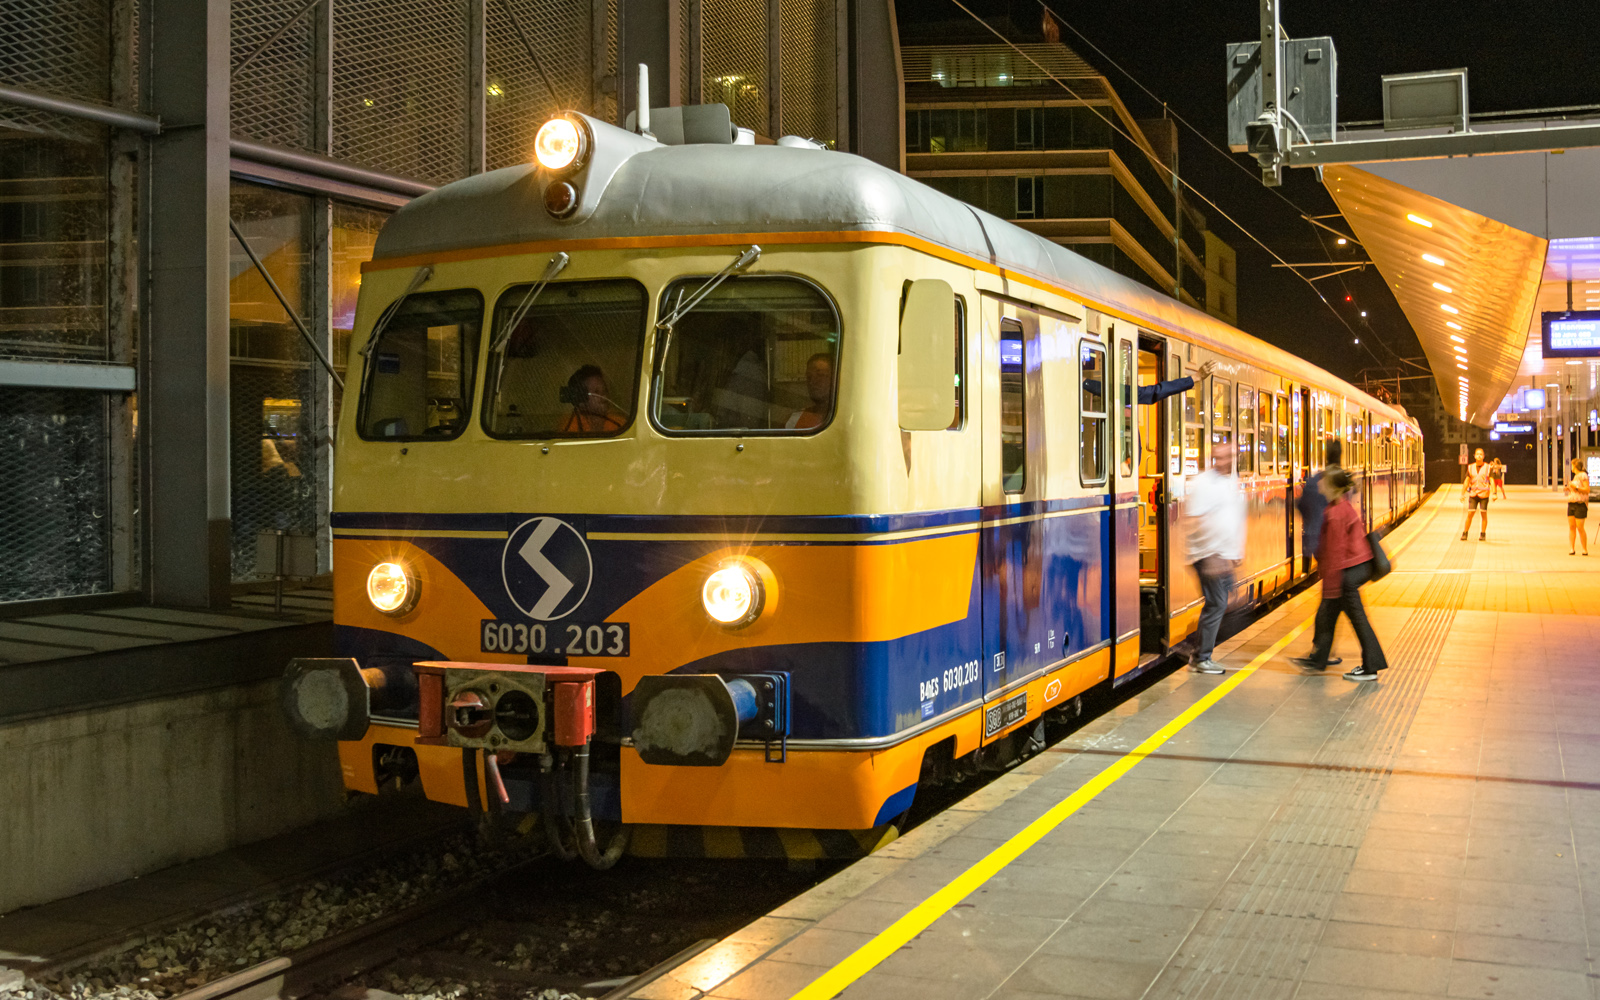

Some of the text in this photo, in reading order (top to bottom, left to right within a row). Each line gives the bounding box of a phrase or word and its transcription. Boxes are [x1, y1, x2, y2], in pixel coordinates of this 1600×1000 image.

[1256, 128, 1269, 147] Z
[484, 623, 624, 655] 6030.203
[943, 659, 979, 693] 6030.203
